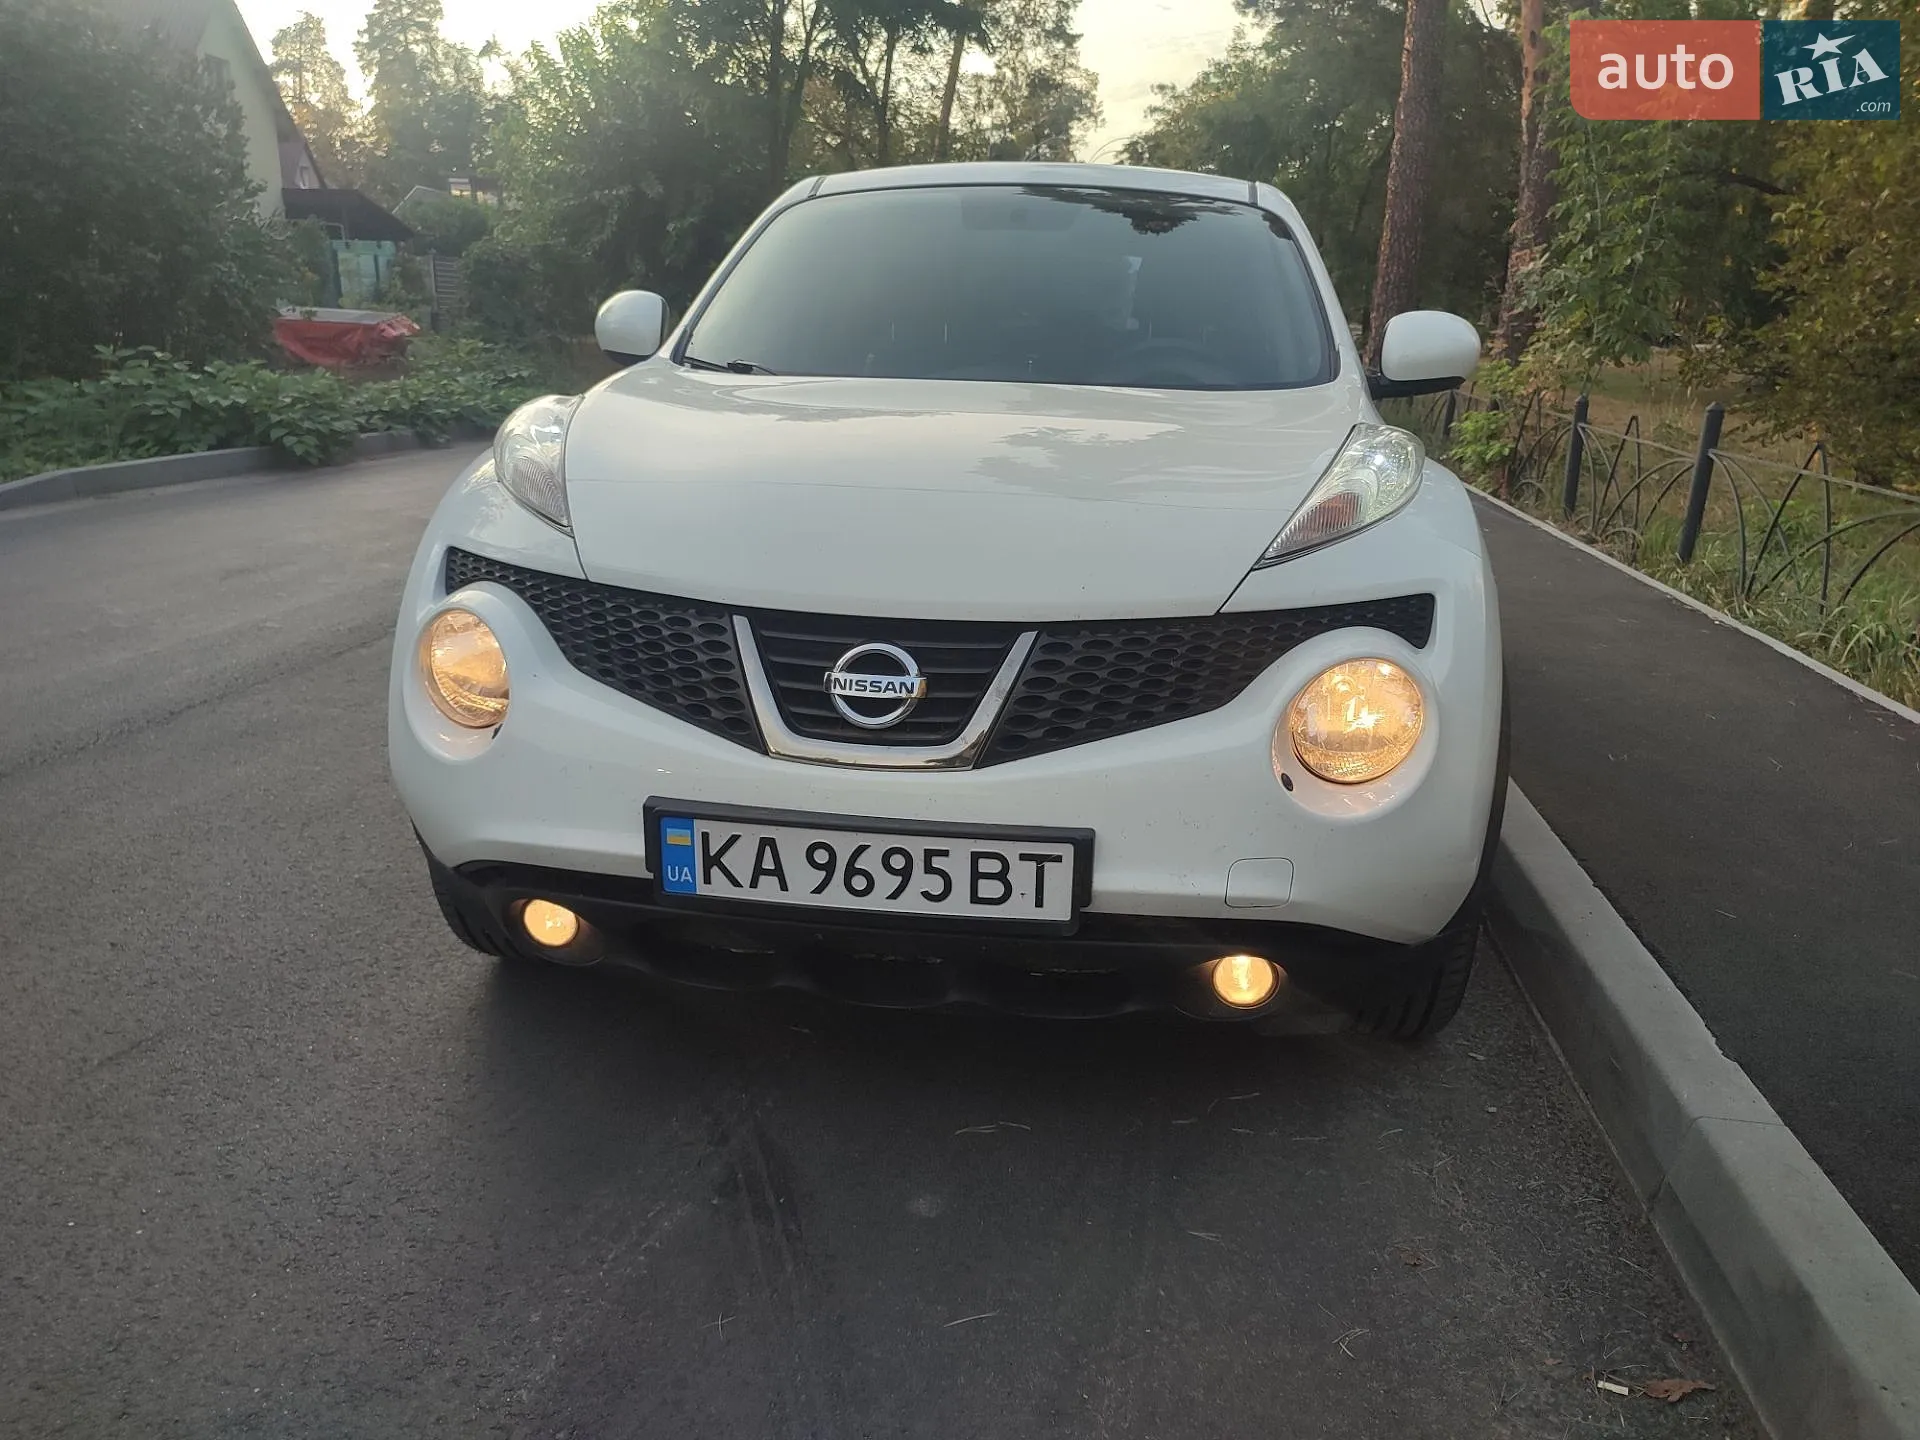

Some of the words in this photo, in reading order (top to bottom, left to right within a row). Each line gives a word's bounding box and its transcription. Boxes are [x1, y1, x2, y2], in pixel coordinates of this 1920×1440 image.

[832, 677, 915, 695] NISSAN
[667, 865, 693, 884] UA
[700, 831, 789, 892] KA
[805, 841, 953, 903] 9695
[969, 850, 1063, 909] BT
